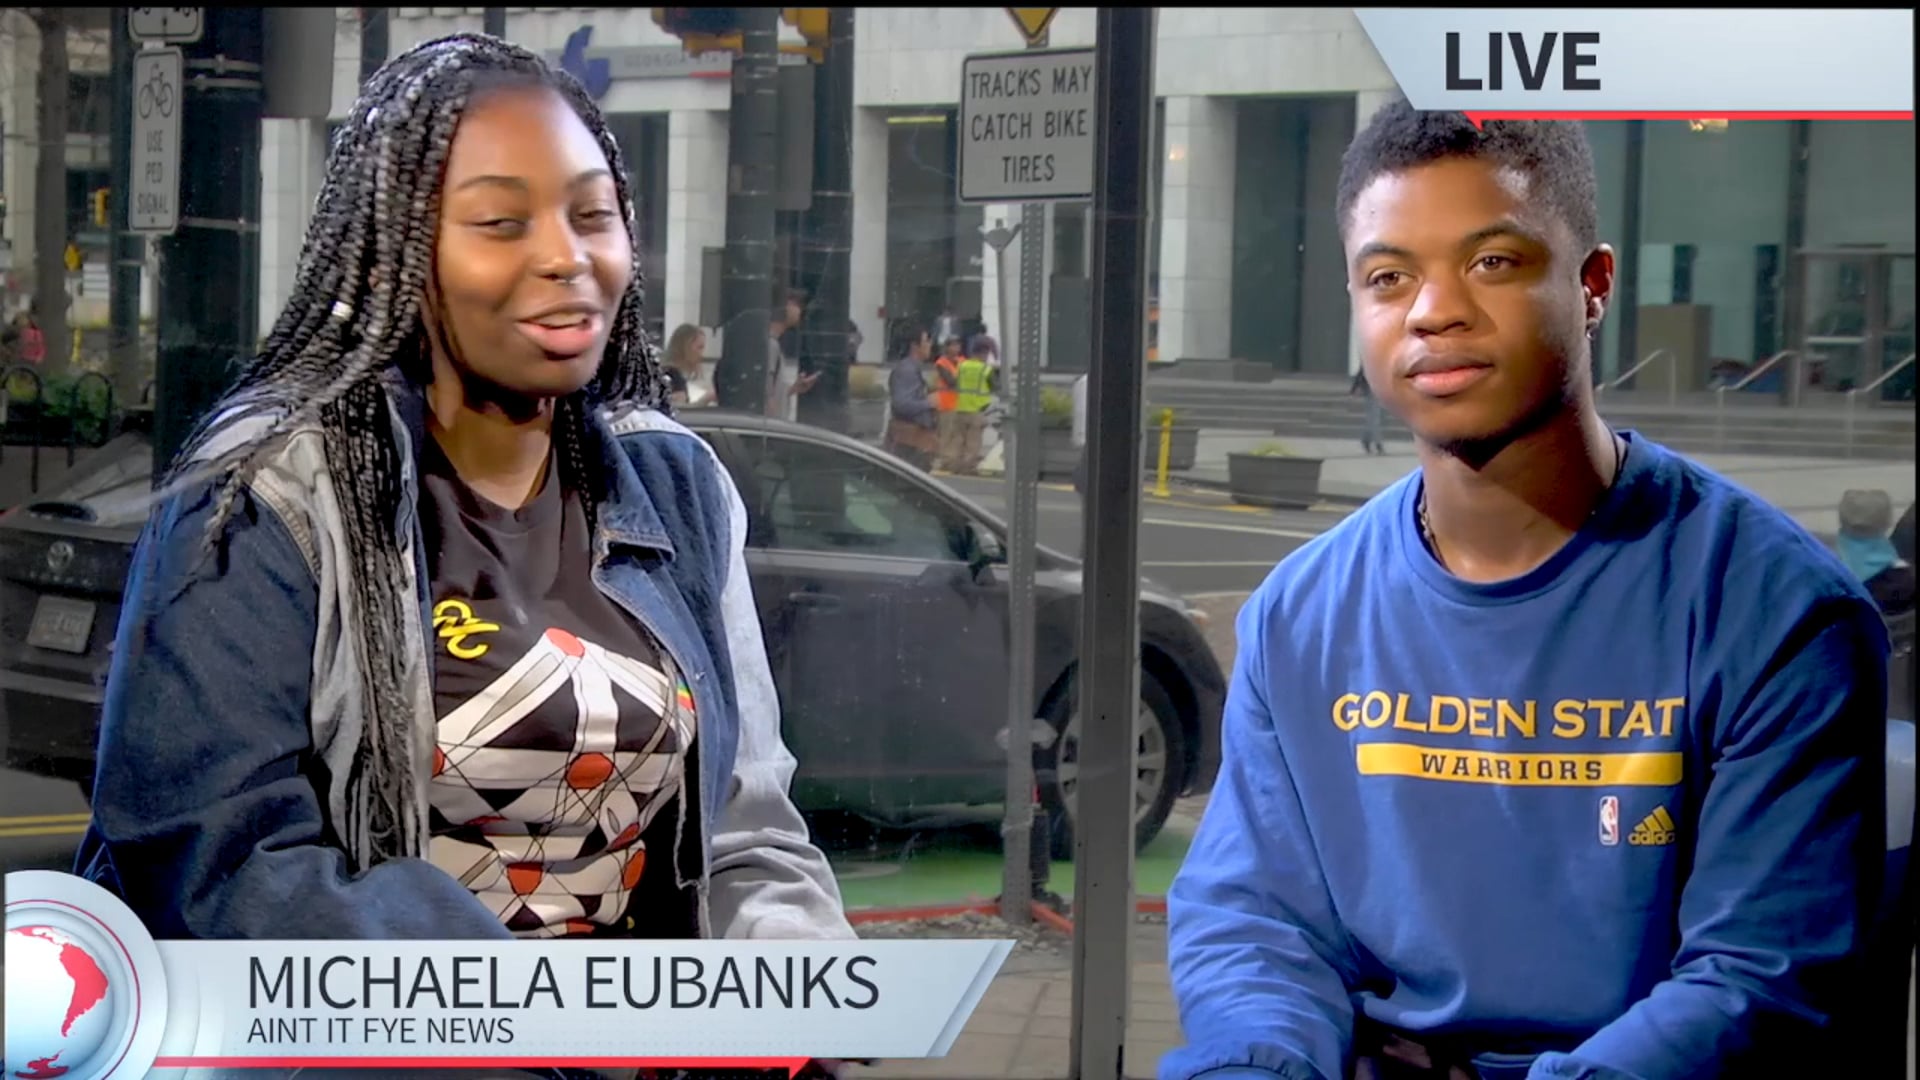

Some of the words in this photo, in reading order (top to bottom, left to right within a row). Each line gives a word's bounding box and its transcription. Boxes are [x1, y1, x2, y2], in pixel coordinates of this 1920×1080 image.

[970, 69, 1041, 99] TRACKS
[1052, 65, 1092, 94] MAY
[971, 112, 1033, 141] CATCH
[1044, 109, 1088, 138] BIKE
[146, 129, 163, 152] USE
[145, 162, 163, 184] PED
[1002, 154, 1056, 183] TIRES
[137, 193, 168, 214] SIGNAL
[1332, 689, 1537, 739] GOLDEN
[1552, 695, 1686, 739] STAT
[1421, 752, 1604, 781] WARRIORS
[1627, 829, 1675, 845] adida
